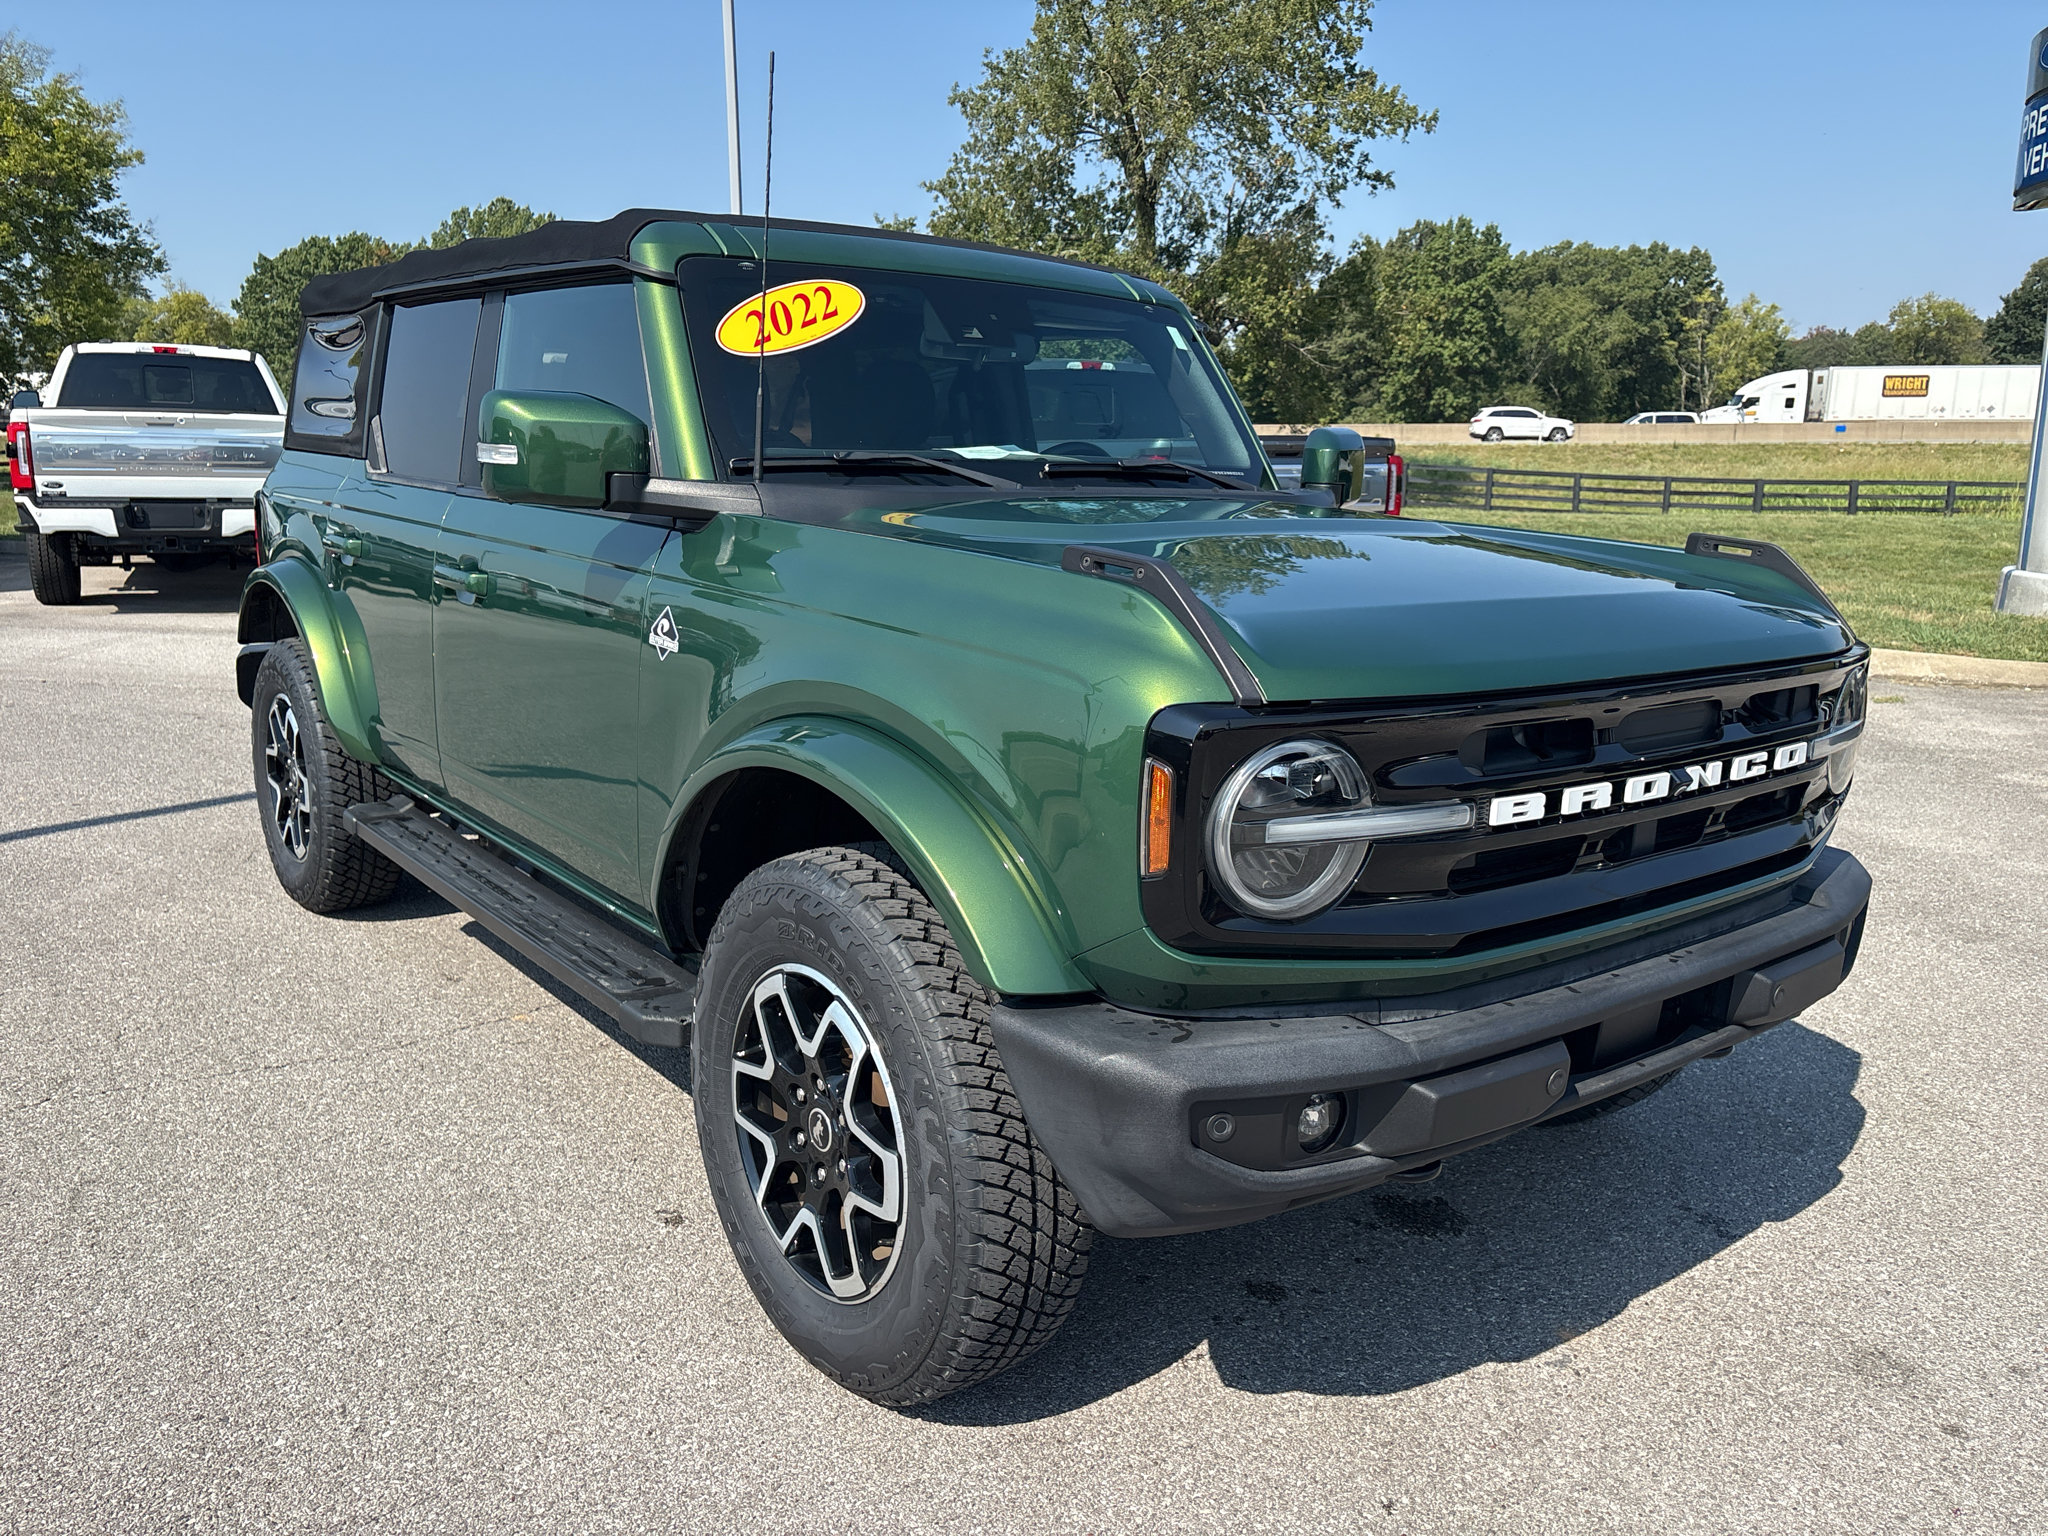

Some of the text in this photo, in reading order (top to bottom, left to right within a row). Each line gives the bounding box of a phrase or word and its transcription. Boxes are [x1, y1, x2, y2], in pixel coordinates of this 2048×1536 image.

[2021, 104, 2048, 144] PRE
[745, 286, 838, 348] 2022
[1885, 377, 1929, 390] WRIGHT
[1488, 741, 1808, 827] BRONCO
